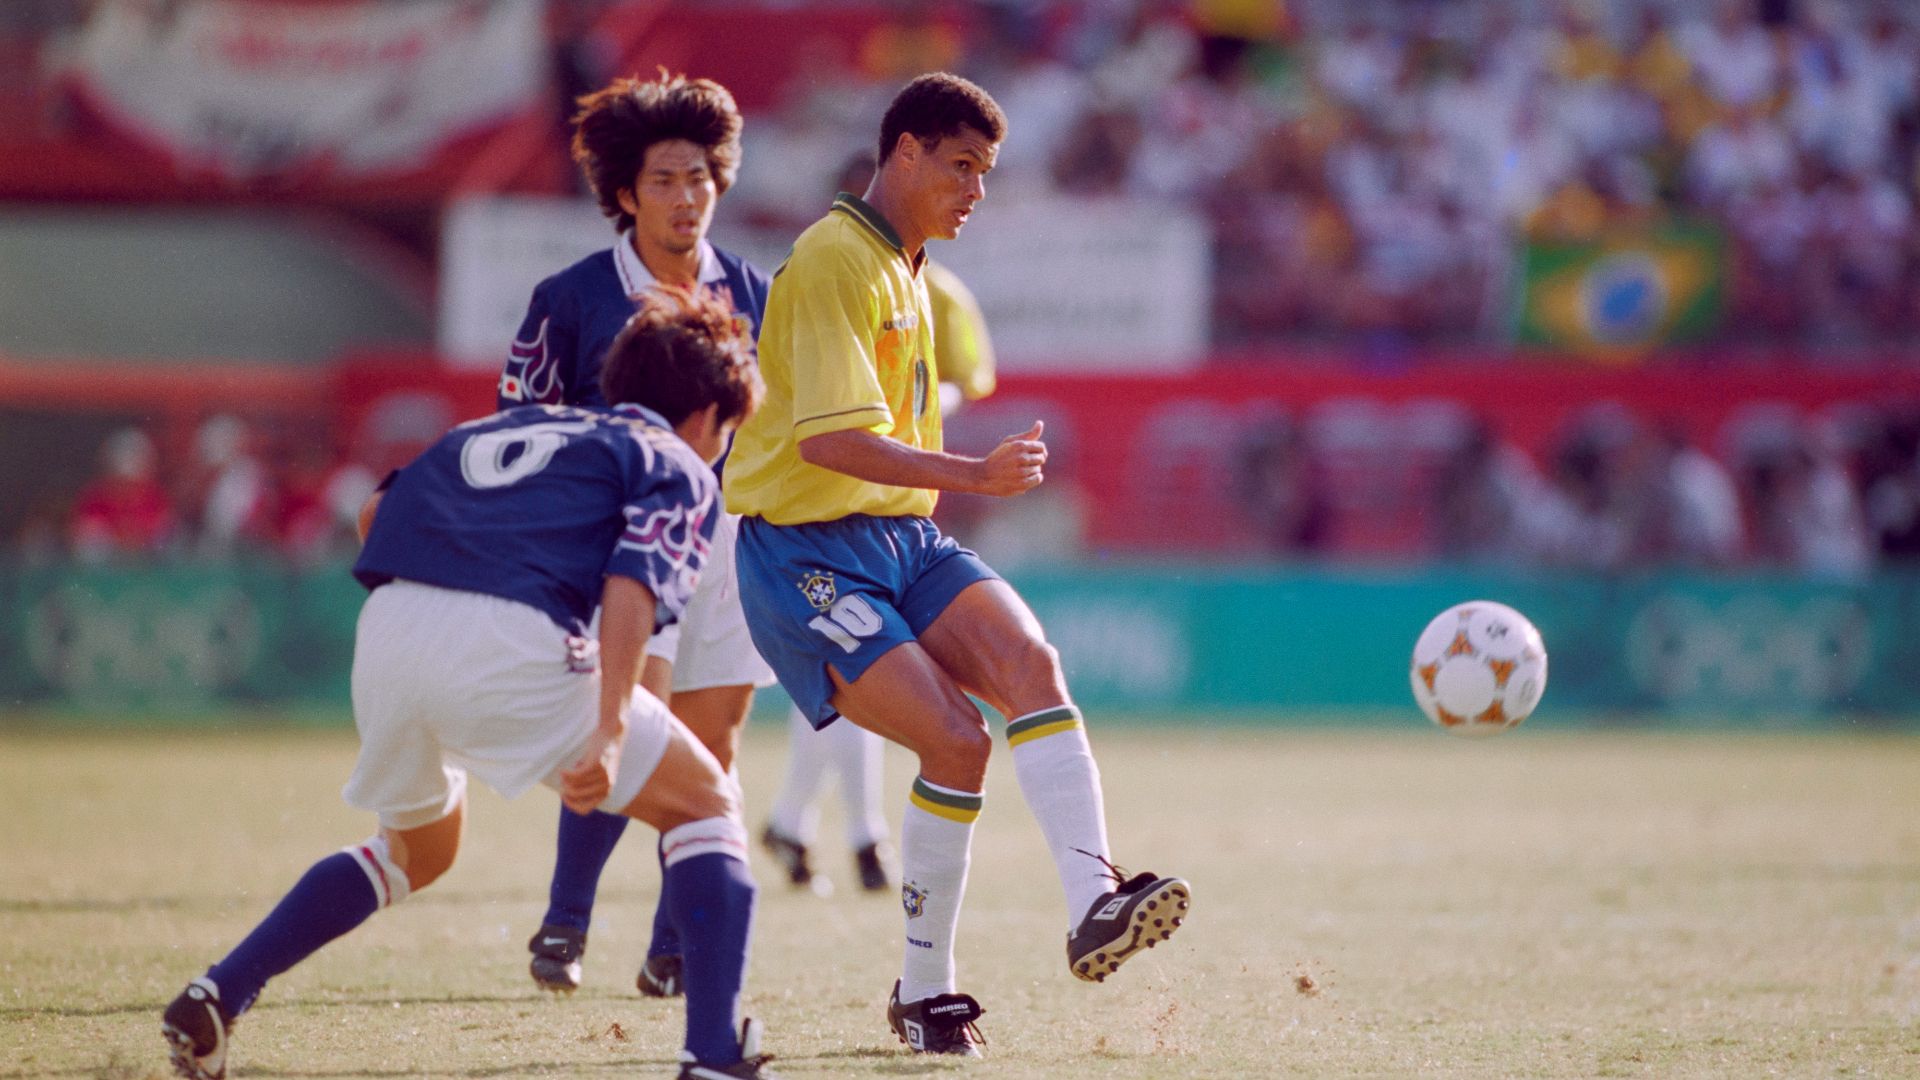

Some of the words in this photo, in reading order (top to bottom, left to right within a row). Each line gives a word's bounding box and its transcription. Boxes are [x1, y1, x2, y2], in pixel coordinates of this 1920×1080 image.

[460, 422, 596, 489] 6
[808, 594, 883, 653] 10
[906, 936, 933, 949] BRO
[930, 1003, 968, 1014] UMBRO
